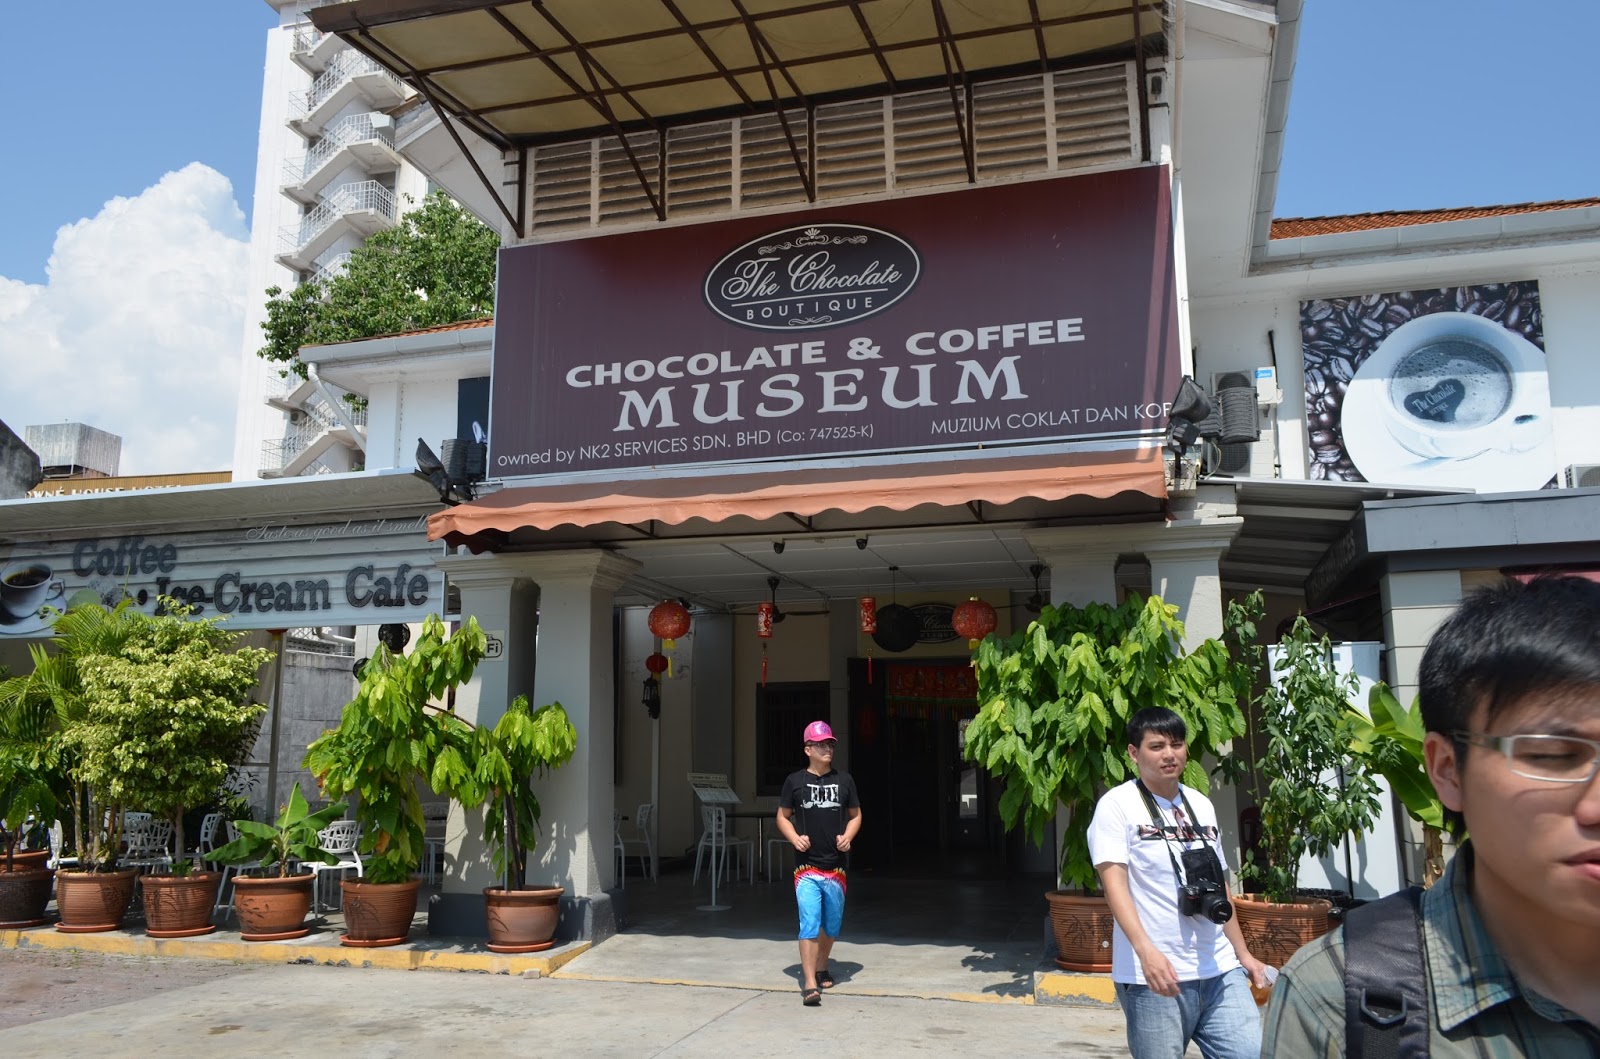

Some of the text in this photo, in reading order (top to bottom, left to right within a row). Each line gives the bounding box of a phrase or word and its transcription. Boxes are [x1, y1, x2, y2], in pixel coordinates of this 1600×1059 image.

[721, 251, 902, 300] The Chocolate
[746, 297, 872, 320] BOUTIQUE
[565, 317, 1085, 388] CHOCOLATE & COFFEE
[612, 355, 1029, 432] MUSEUM
[931, 416, 1001, 434] MUZIUM
[1006, 409, 1080, 429] COKLAT
[1086, 405, 1128, 422] DAN
[497, 424, 874, 467] owned by NK2 SERVICES SDN. BHD (Co: 747525-K)
[246, 513, 429, 544] Taste as good as it smell
[72, 536, 178, 578] Coffee
[154, 563, 429, 617] Ice-Cream Cafe
